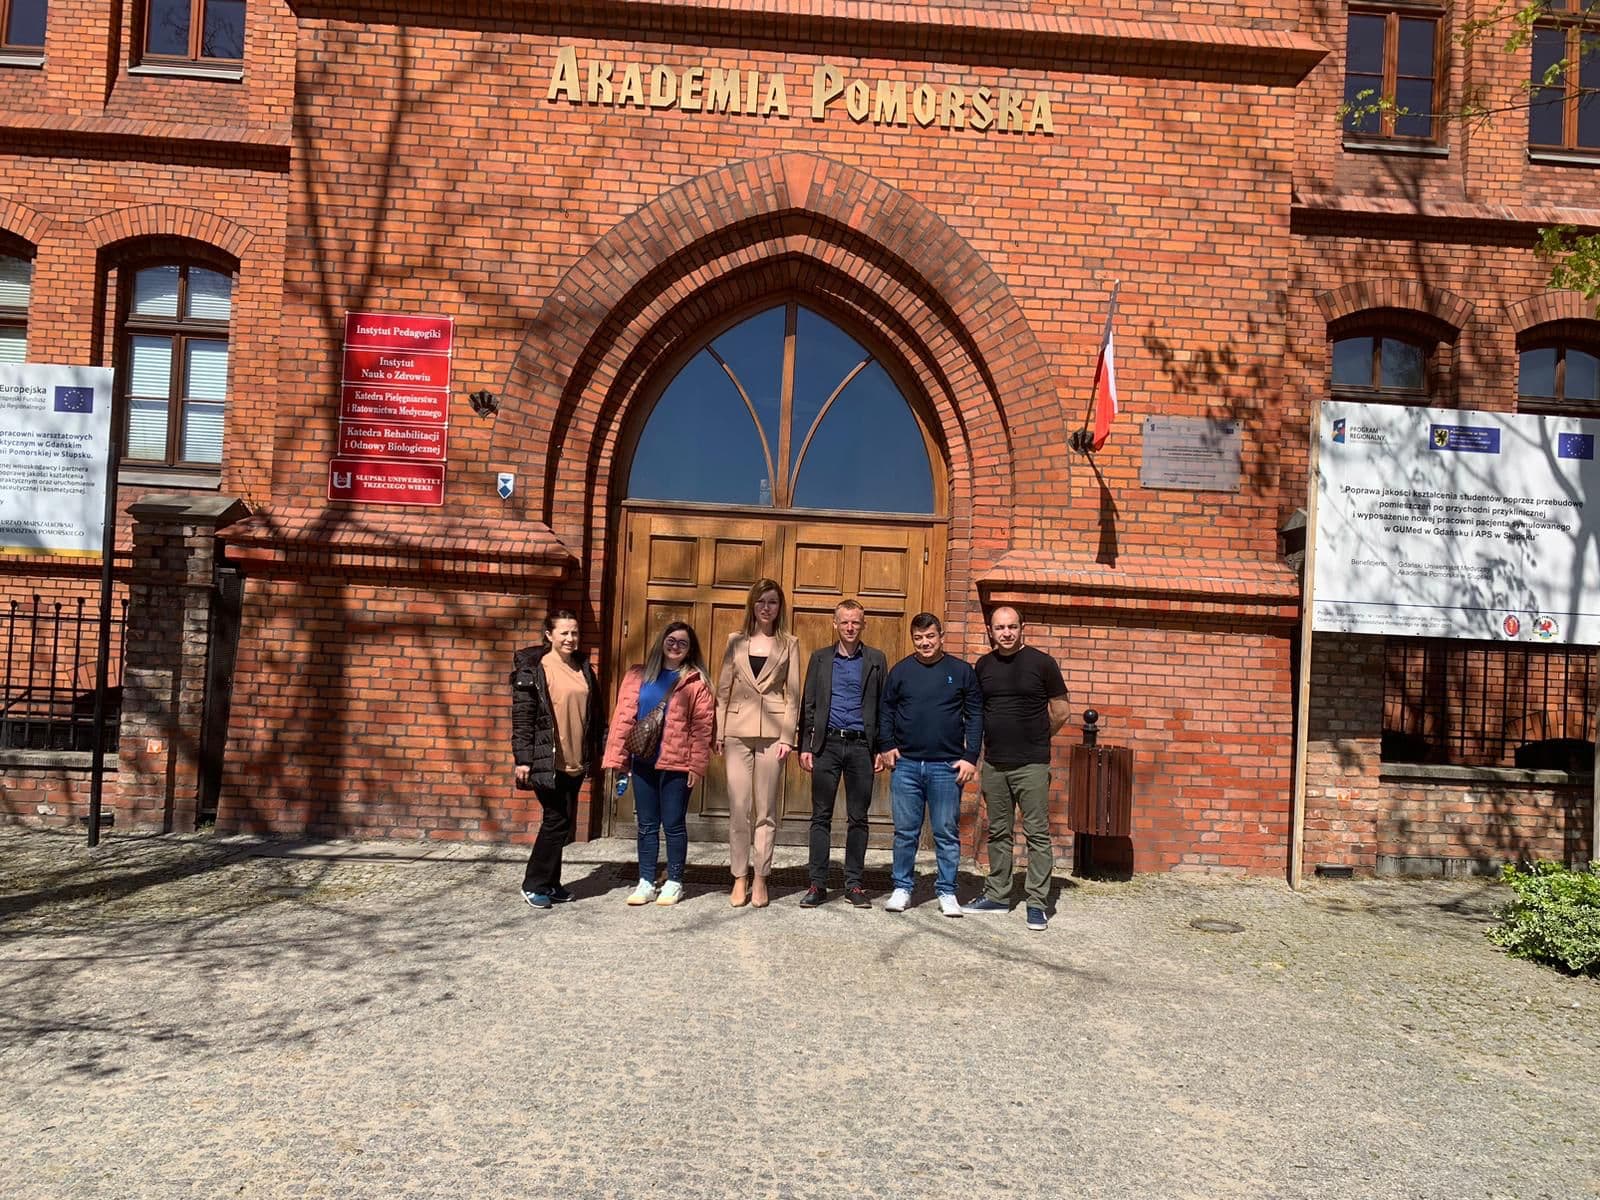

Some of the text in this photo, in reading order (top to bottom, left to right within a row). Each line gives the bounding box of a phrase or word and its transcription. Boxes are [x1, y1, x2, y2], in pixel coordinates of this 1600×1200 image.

[547, 45, 1054, 135] AKADEMIA POMORSKA
[356, 324, 441, 339] Instytut Pedagogiki
[379, 356, 415, 368] Instytut
[361, 368, 385, 379] Nauk
[394, 371, 431, 382] Zdrowiu
[0, 384, 47, 396] Europejska
[354, 390, 438, 404] Katedra Pielęgniarstwa
[346, 403, 442, 419] i Ratownictwa Medycznego
[36, 431, 93, 442] warsztatowych
[347, 427, 440, 442] Katedra Rehabilitacji
[1350, 425, 1379, 434] PROGRAM
[1350, 433, 1386, 441] REGIONALNY
[45, 440, 82, 449] Gdańskim
[344, 440, 441, 455] i Odnowy Biologicznej
[9, 448, 52, 458] Pomorskiej
[362, 481, 434, 492] TRZECIEGO WIEKU
[388, 476, 441, 485] UNIWERSYTET
[1382, 487, 1411, 497] jakości
[1412, 488, 1458, 500] kształcenia
[1460, 493, 1501, 503] studentów
[1503, 496, 1535, 505] poprzez
[1379, 500, 1547, 519] pomieszczeń po przychodni przyklinicznej
[1357, 512, 1410, 521] wyposażenie
[1411, 515, 1436, 524] nowej
[1437, 516, 1474, 525] pracowni
[1475, 519, 1510, 529] pacjenta
[1383, 525, 1392, 533] w
[1392, 524, 1423, 535] GUMed
[1433, 527, 1470, 537] Gdańsku
[1475, 529, 1493, 539] APS
